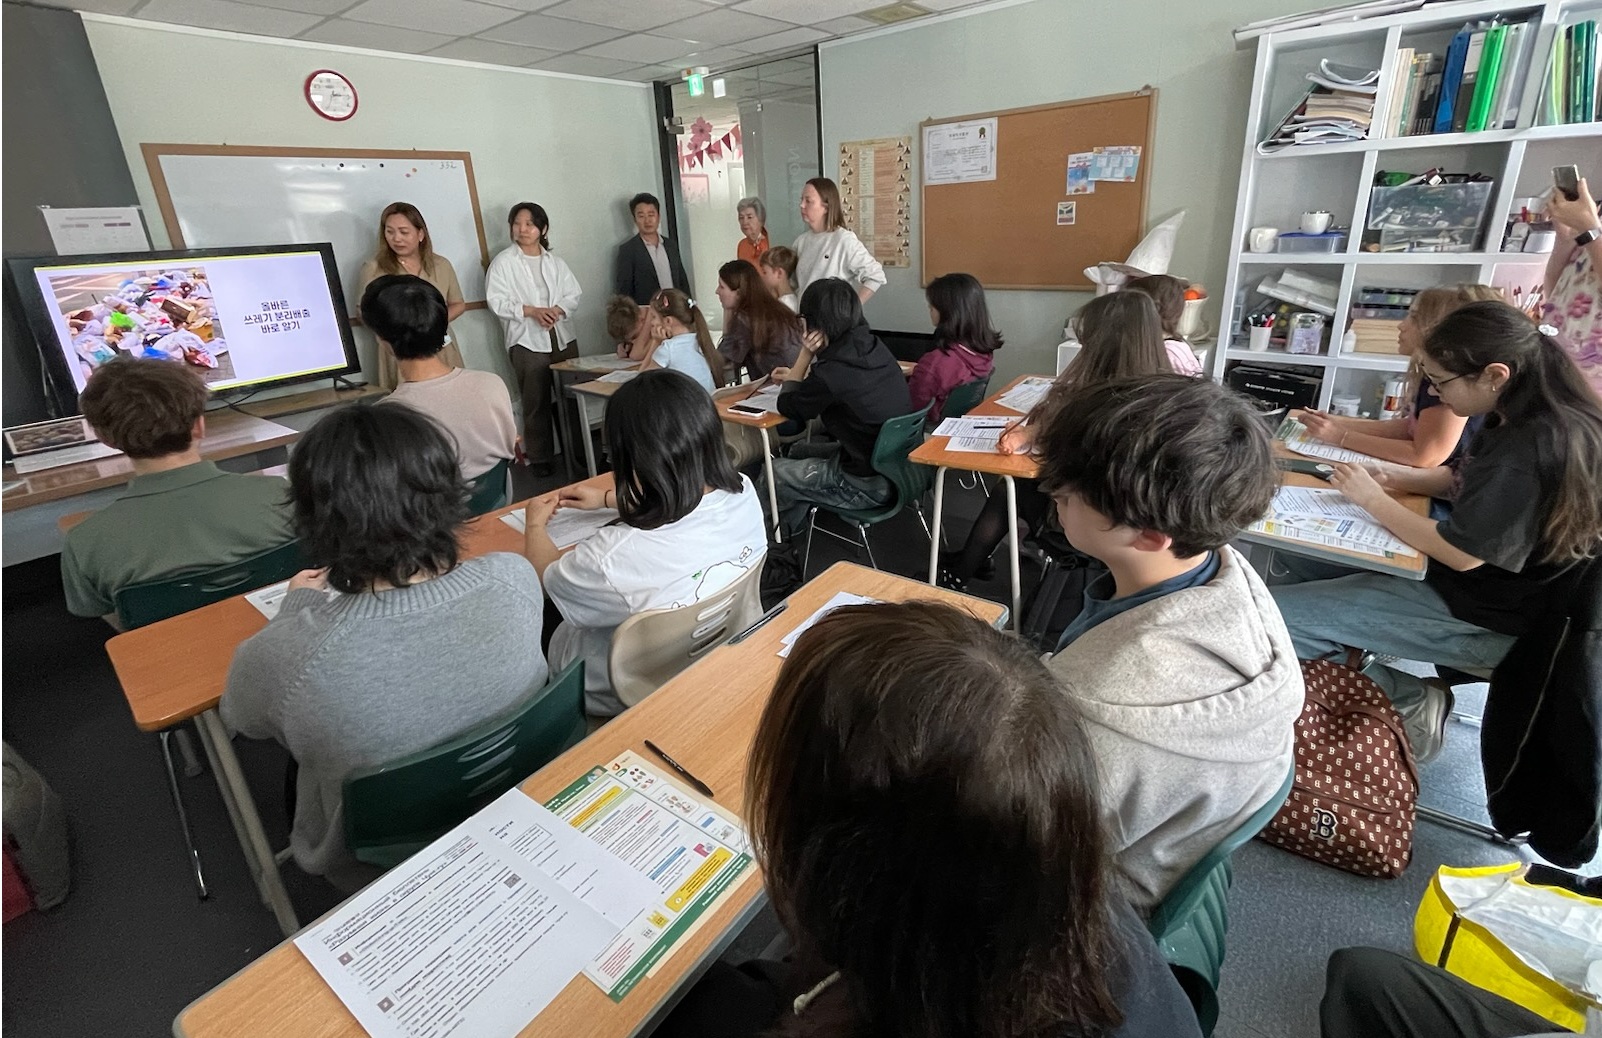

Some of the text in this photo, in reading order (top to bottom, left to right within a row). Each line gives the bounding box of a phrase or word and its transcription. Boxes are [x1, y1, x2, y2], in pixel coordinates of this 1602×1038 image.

[261, 300, 289, 311] 올바른
[244, 309, 311, 325] 쓰레기 분리배출
[261, 321, 300, 334] 바로 알기
[1310, 807, 1338, 841] B
